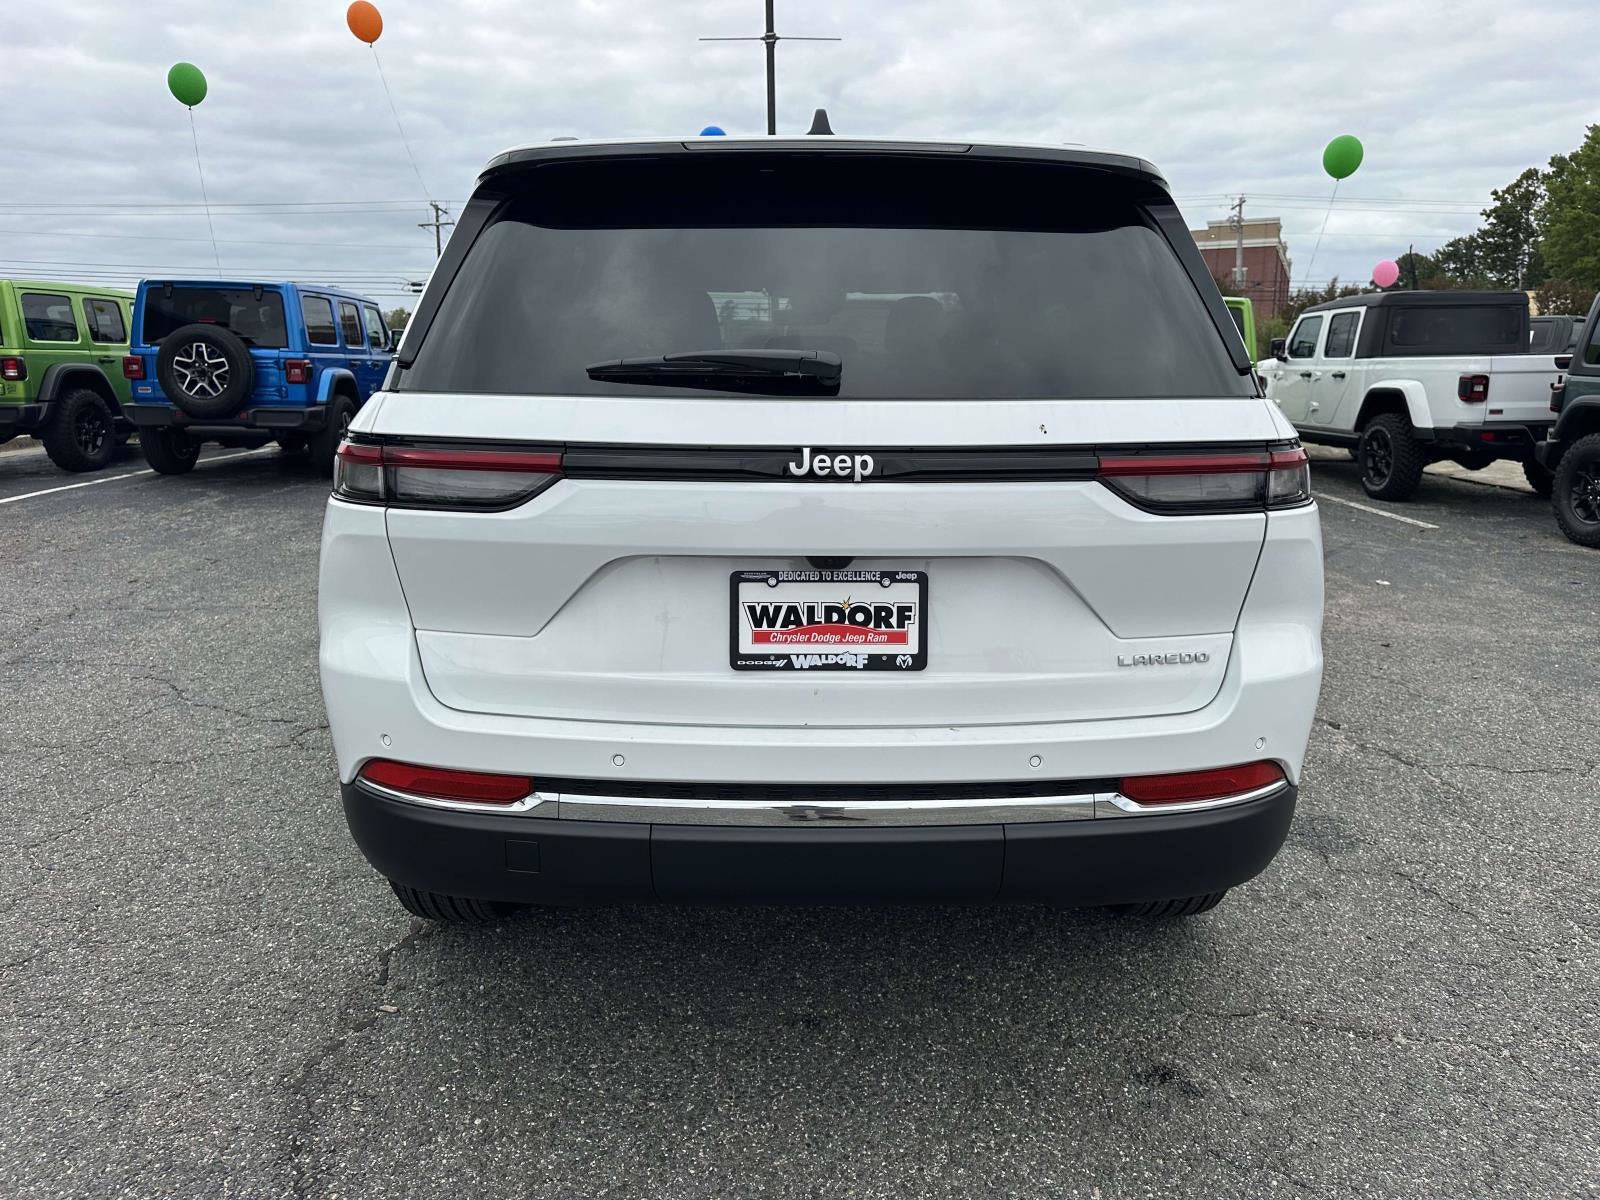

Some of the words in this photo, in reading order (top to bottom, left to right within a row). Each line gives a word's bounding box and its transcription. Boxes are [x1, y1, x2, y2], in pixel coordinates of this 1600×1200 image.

[789, 447, 874, 482] Jeep
[779, 572, 820, 581] DEDICATED
[822, 572, 832, 581] TO
[833, 572, 881, 581] EXCELLENCE
[896, 572, 918, 581] Jeep
[745, 604, 914, 629] WALDORF
[770, 633, 809, 644] Chrysler
[811, 633, 840, 644] Dodge
[841, 633, 866, 644] Jeep
[868, 633, 888, 643] Ram
[790, 654, 868, 668] WALDORF
[1117, 652, 1210, 667] LAREDO
